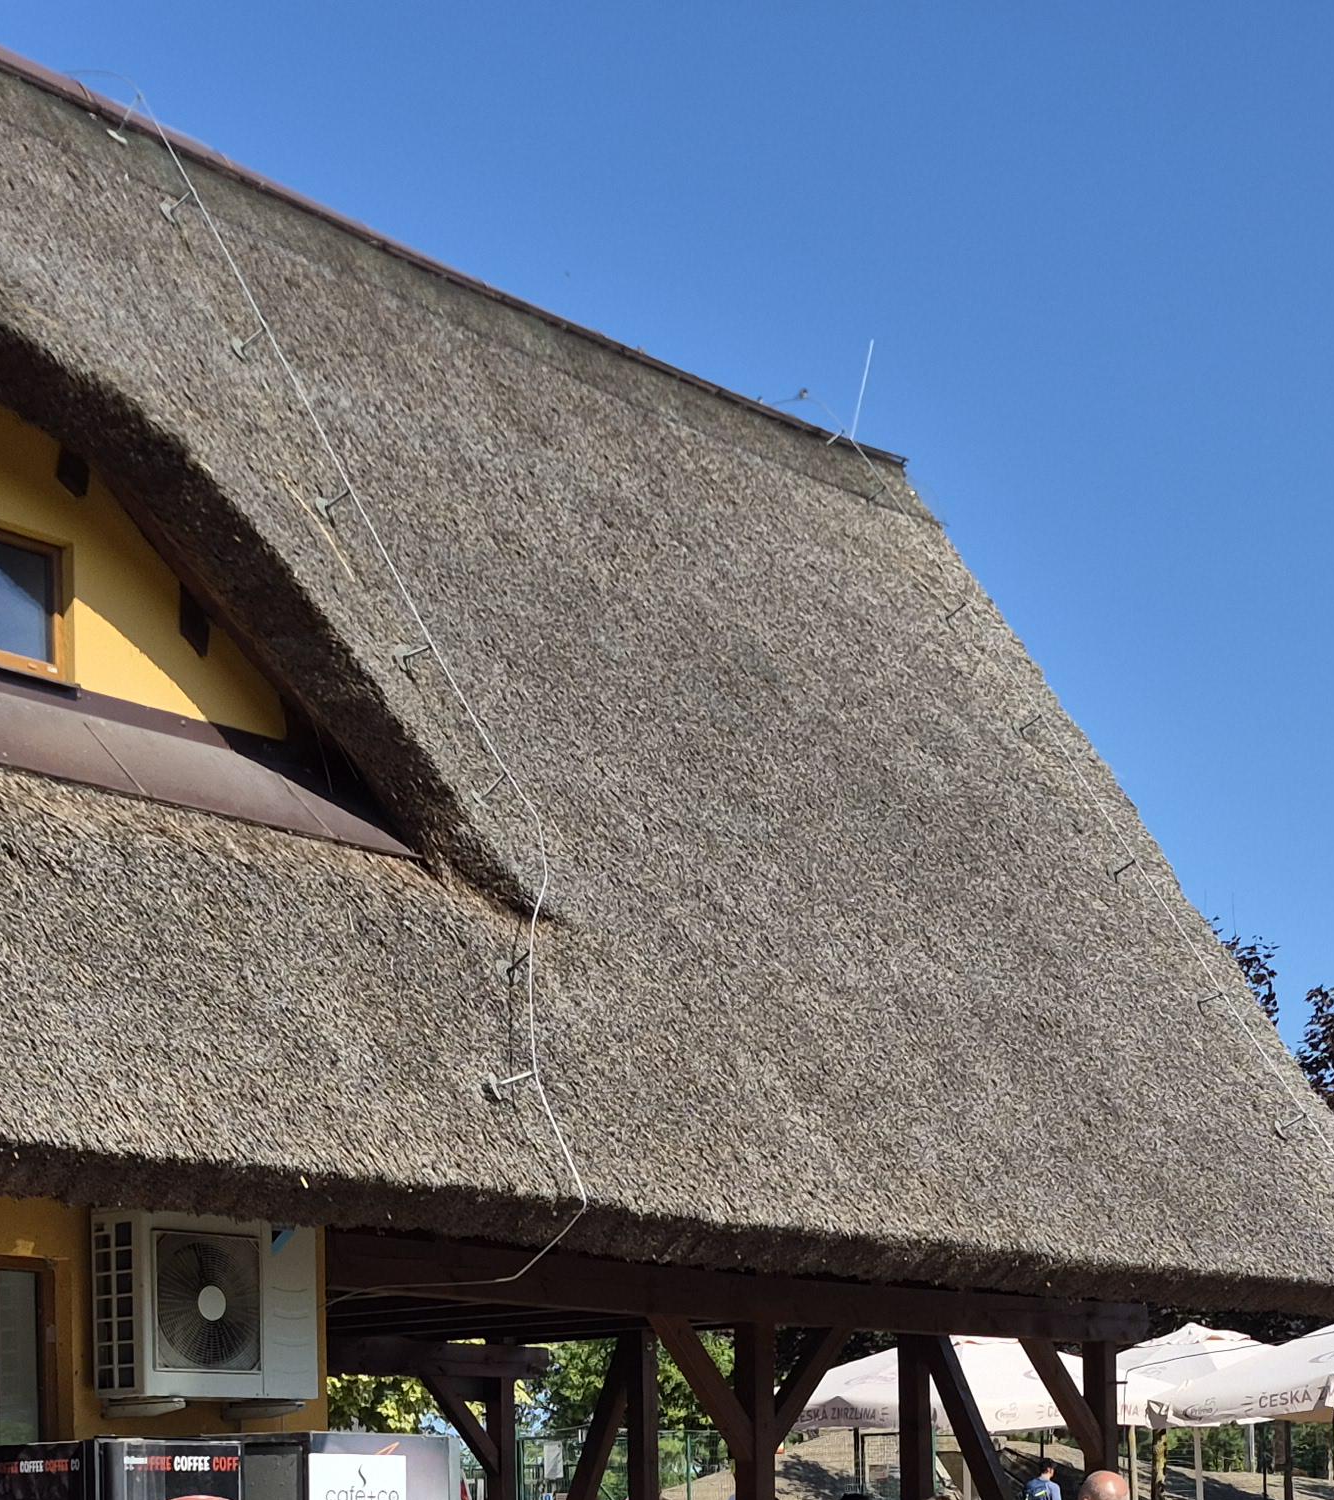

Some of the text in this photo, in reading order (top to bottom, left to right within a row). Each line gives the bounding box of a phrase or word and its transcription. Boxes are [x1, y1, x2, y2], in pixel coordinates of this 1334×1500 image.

[1258, 1385, 1312, 1409] ČESKÁ
[830, 1405, 877, 1421] ZMRZLINA
[19, 1460, 44, 1474] COFFEE
[173, 1455, 211, 1472] COFFEE
[212, 1455, 240, 1472] COFF
